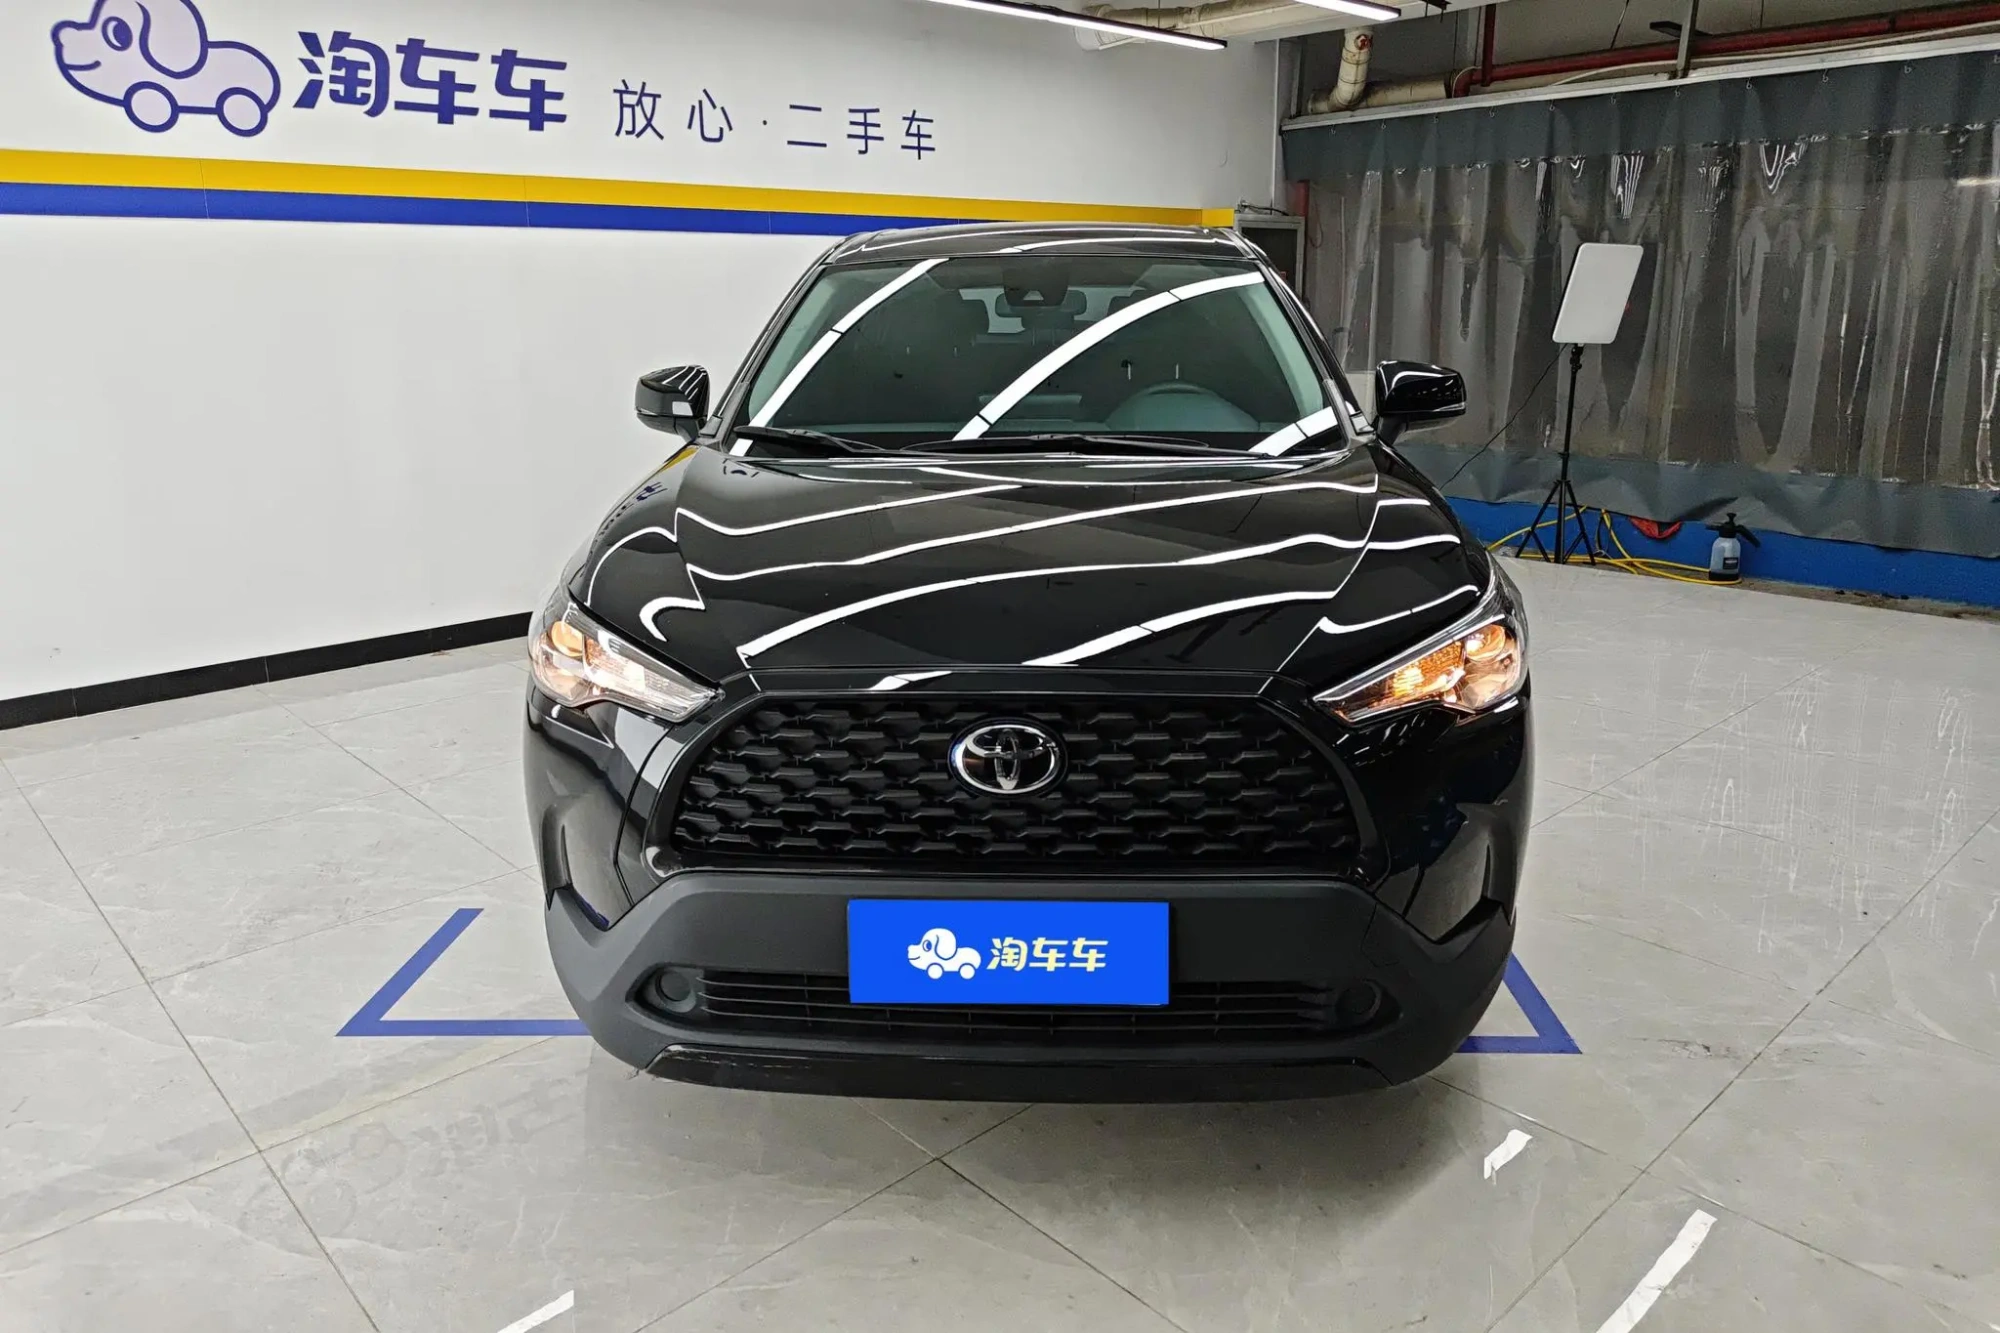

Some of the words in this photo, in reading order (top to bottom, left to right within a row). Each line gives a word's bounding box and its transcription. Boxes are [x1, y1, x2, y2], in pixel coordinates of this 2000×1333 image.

[293, 30, 567, 132] 淘车车
[986, 936, 1109, 972] 淘车车
